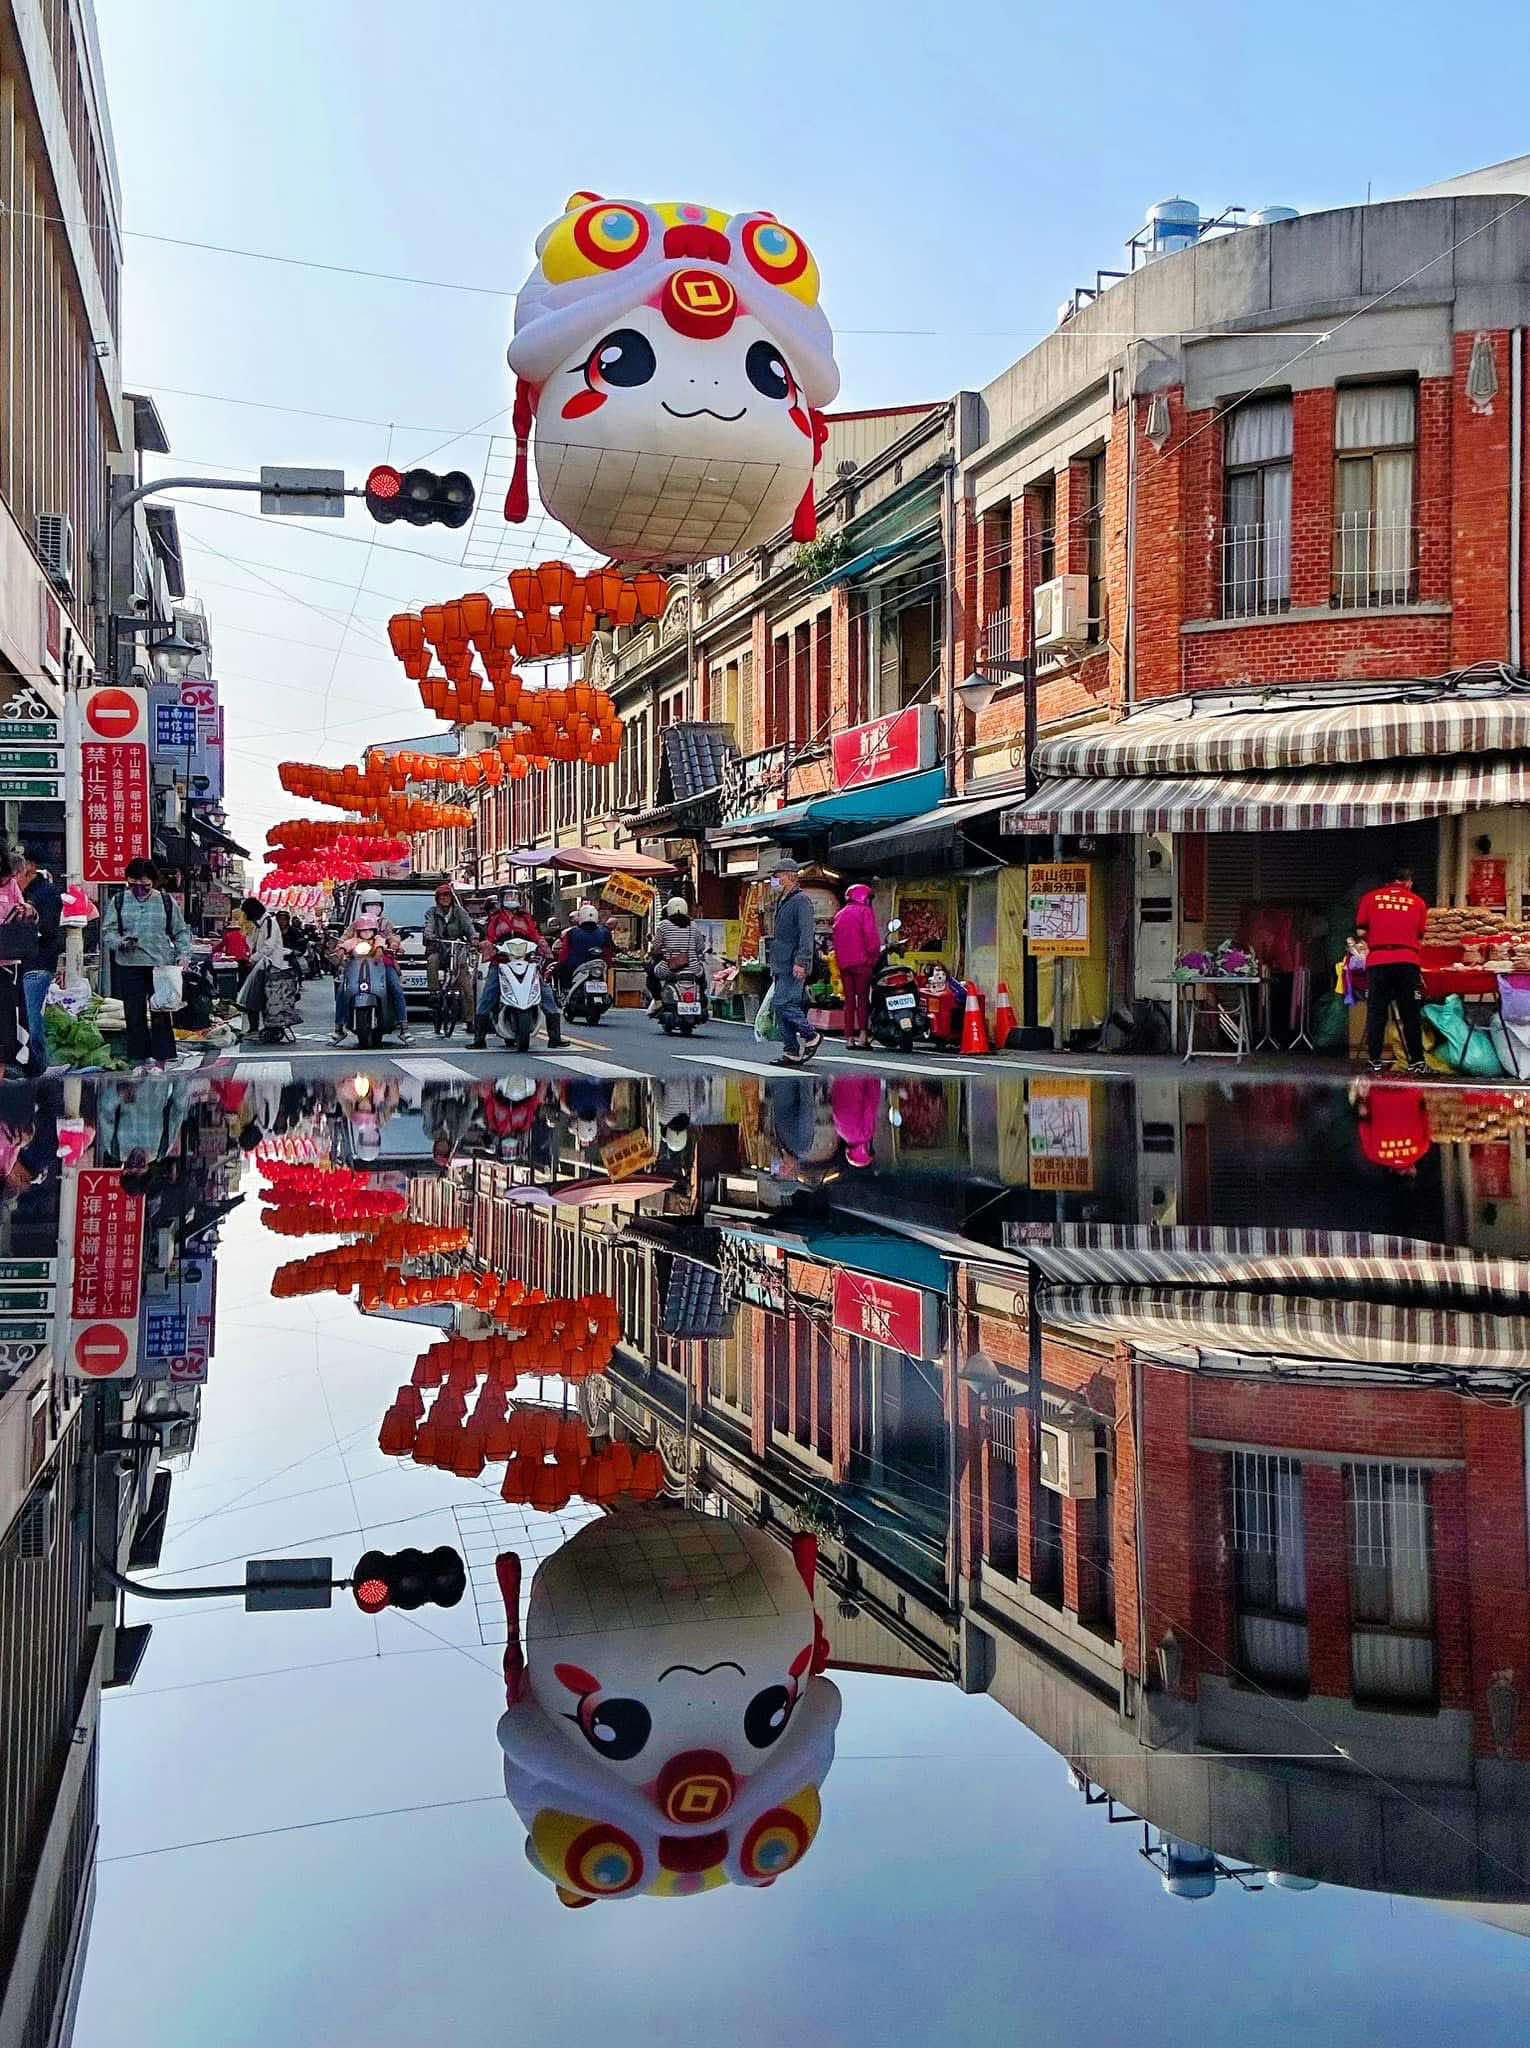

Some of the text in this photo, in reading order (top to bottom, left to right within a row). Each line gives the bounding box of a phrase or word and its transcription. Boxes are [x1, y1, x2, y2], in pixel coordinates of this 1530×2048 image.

[182, 689, 214, 706] OK
[86, 747, 109, 877] 禁止汽機車進入
